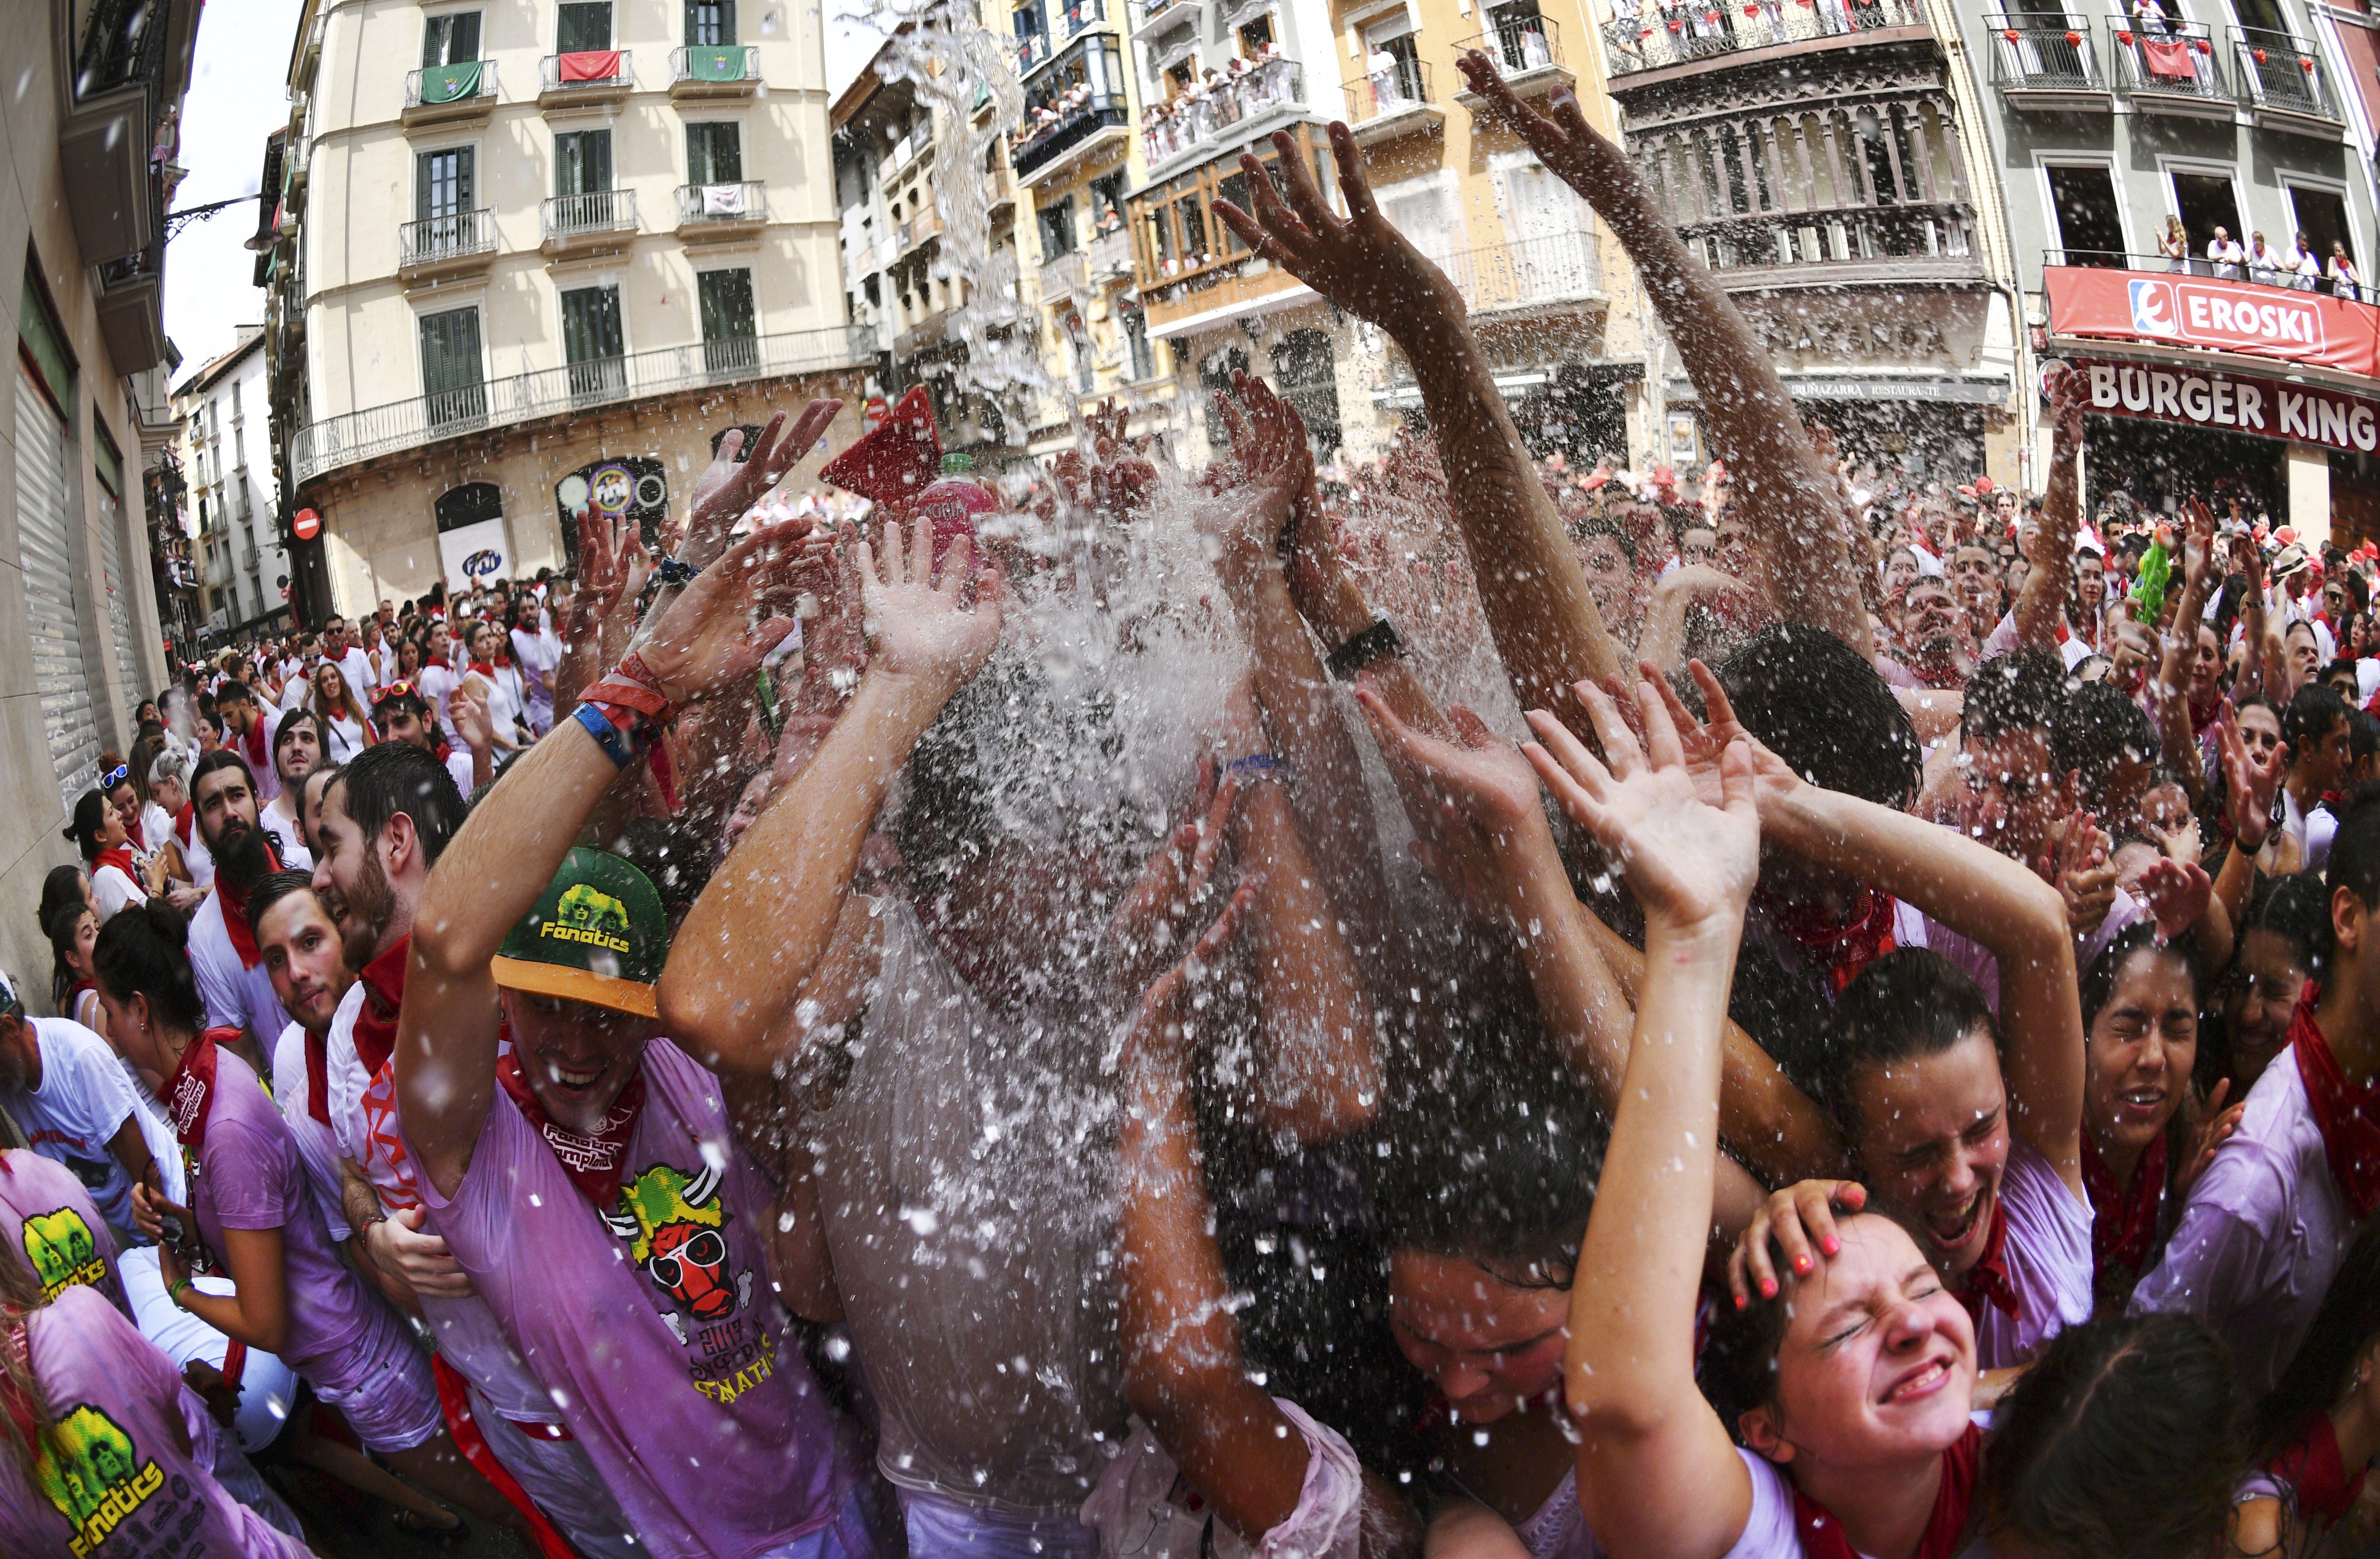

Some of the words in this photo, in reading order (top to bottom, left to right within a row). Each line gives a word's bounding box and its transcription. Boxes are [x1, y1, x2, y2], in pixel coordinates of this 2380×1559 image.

[2187, 295, 2313, 343] EROSKI
[1872, 384, 1940, 397] RESTAURANTE
[2090, 365, 2265, 430] BURGER
[2278, 390, 2377, 451] KING
[540, 921, 630, 953] Fanatics
[179, 1083, 205, 1132] Pamplona
[698, 1316, 744, 1356] 2017
